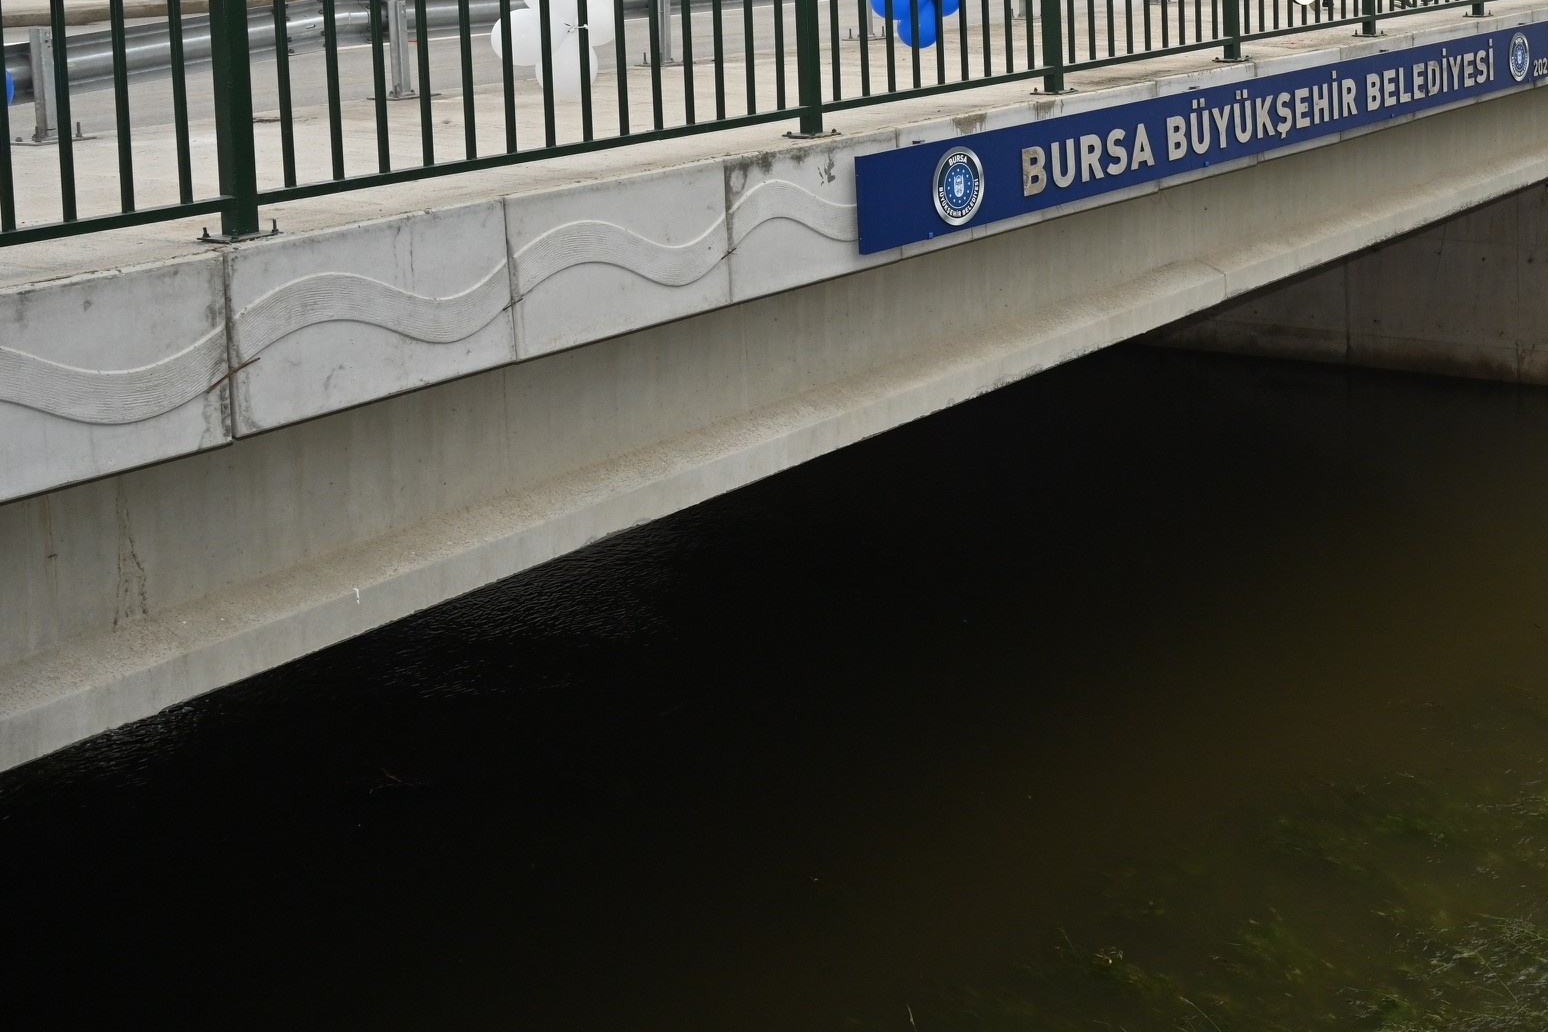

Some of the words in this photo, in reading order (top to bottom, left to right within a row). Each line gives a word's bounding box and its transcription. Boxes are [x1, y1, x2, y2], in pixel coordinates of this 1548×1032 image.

[1021, 122, 1155, 198] BURSA
[1166, 70, 1358, 162] BÜYÜKŞEHİR
[1365, 38, 1495, 112] BELEDİYESİ
[948, 154, 968, 166] BURSA
[938, 186, 962, 217] BÜYÜKŞEHİR
[962, 178, 979, 216] BELEDİYESİ
